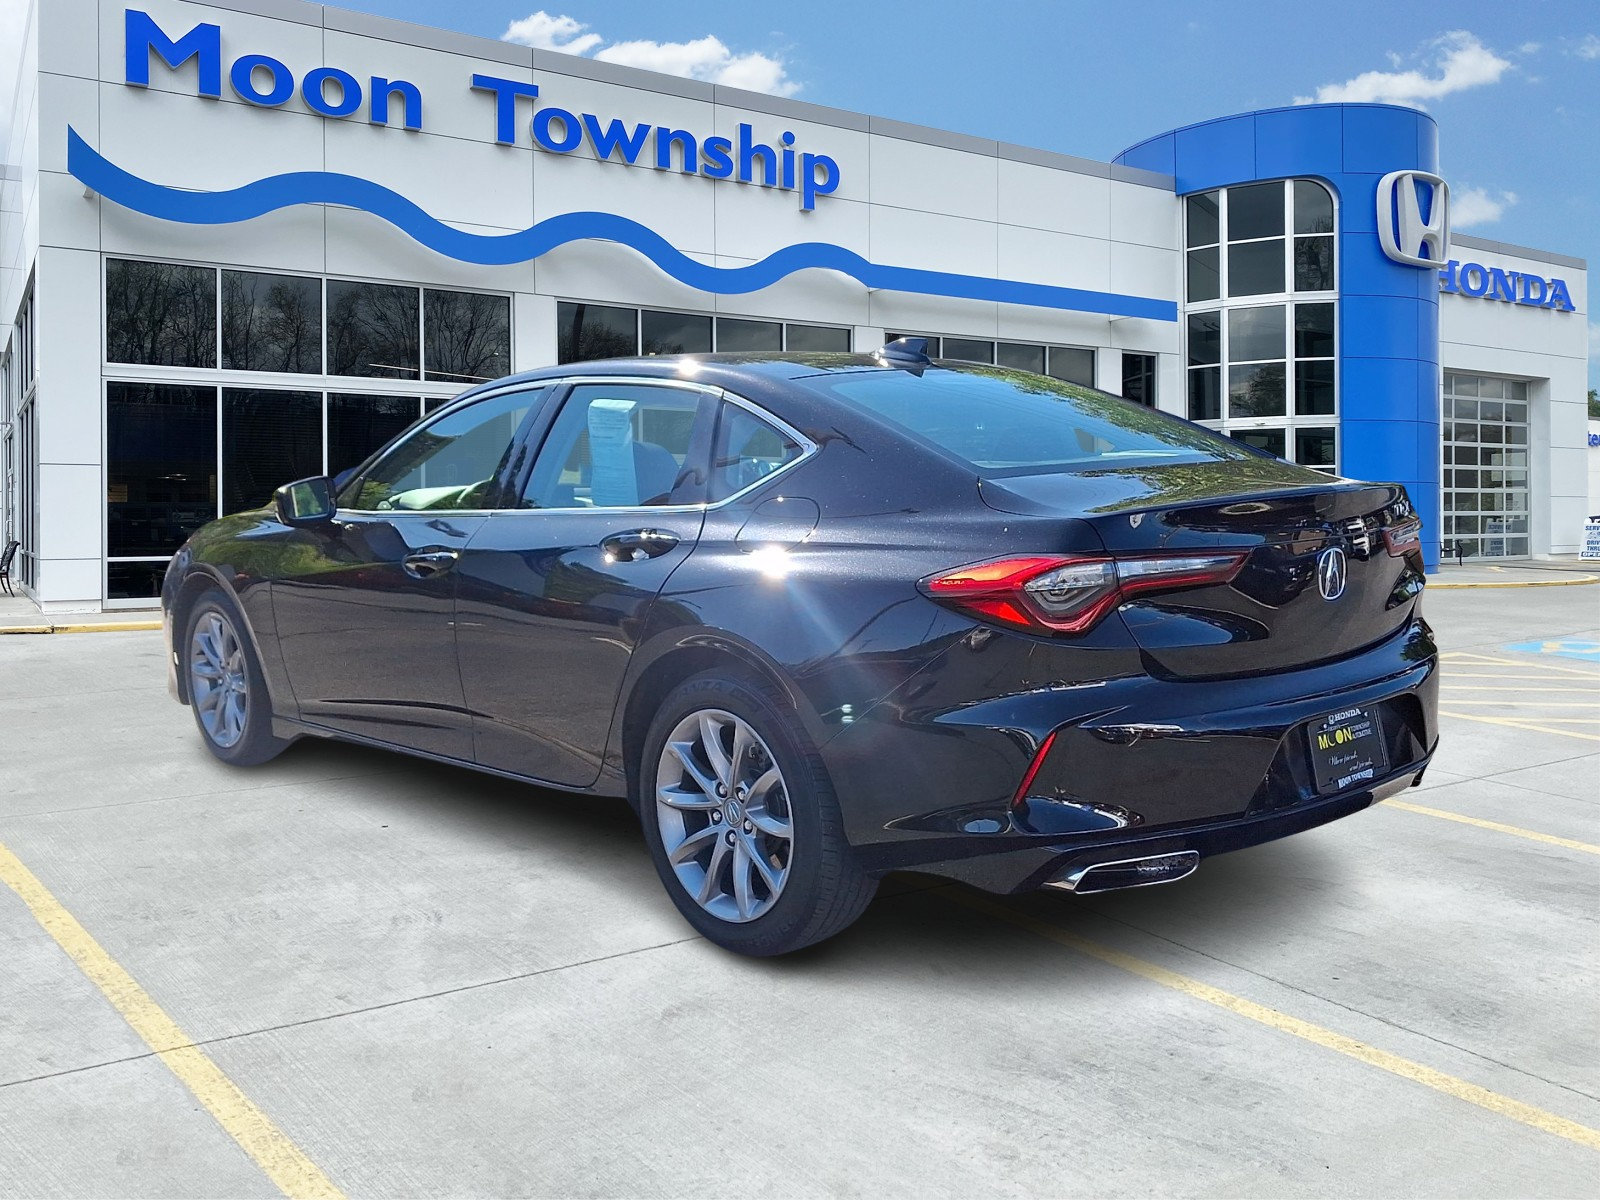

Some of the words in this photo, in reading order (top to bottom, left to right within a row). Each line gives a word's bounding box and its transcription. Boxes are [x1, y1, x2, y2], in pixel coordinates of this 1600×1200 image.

[124, 9, 422, 132] Moon
[471, 74, 841, 212] Township
[1439, 259, 1576, 312] HONDA
[1334, 708, 1361, 720] HONDA
[1318, 727, 1352, 750] MOON
